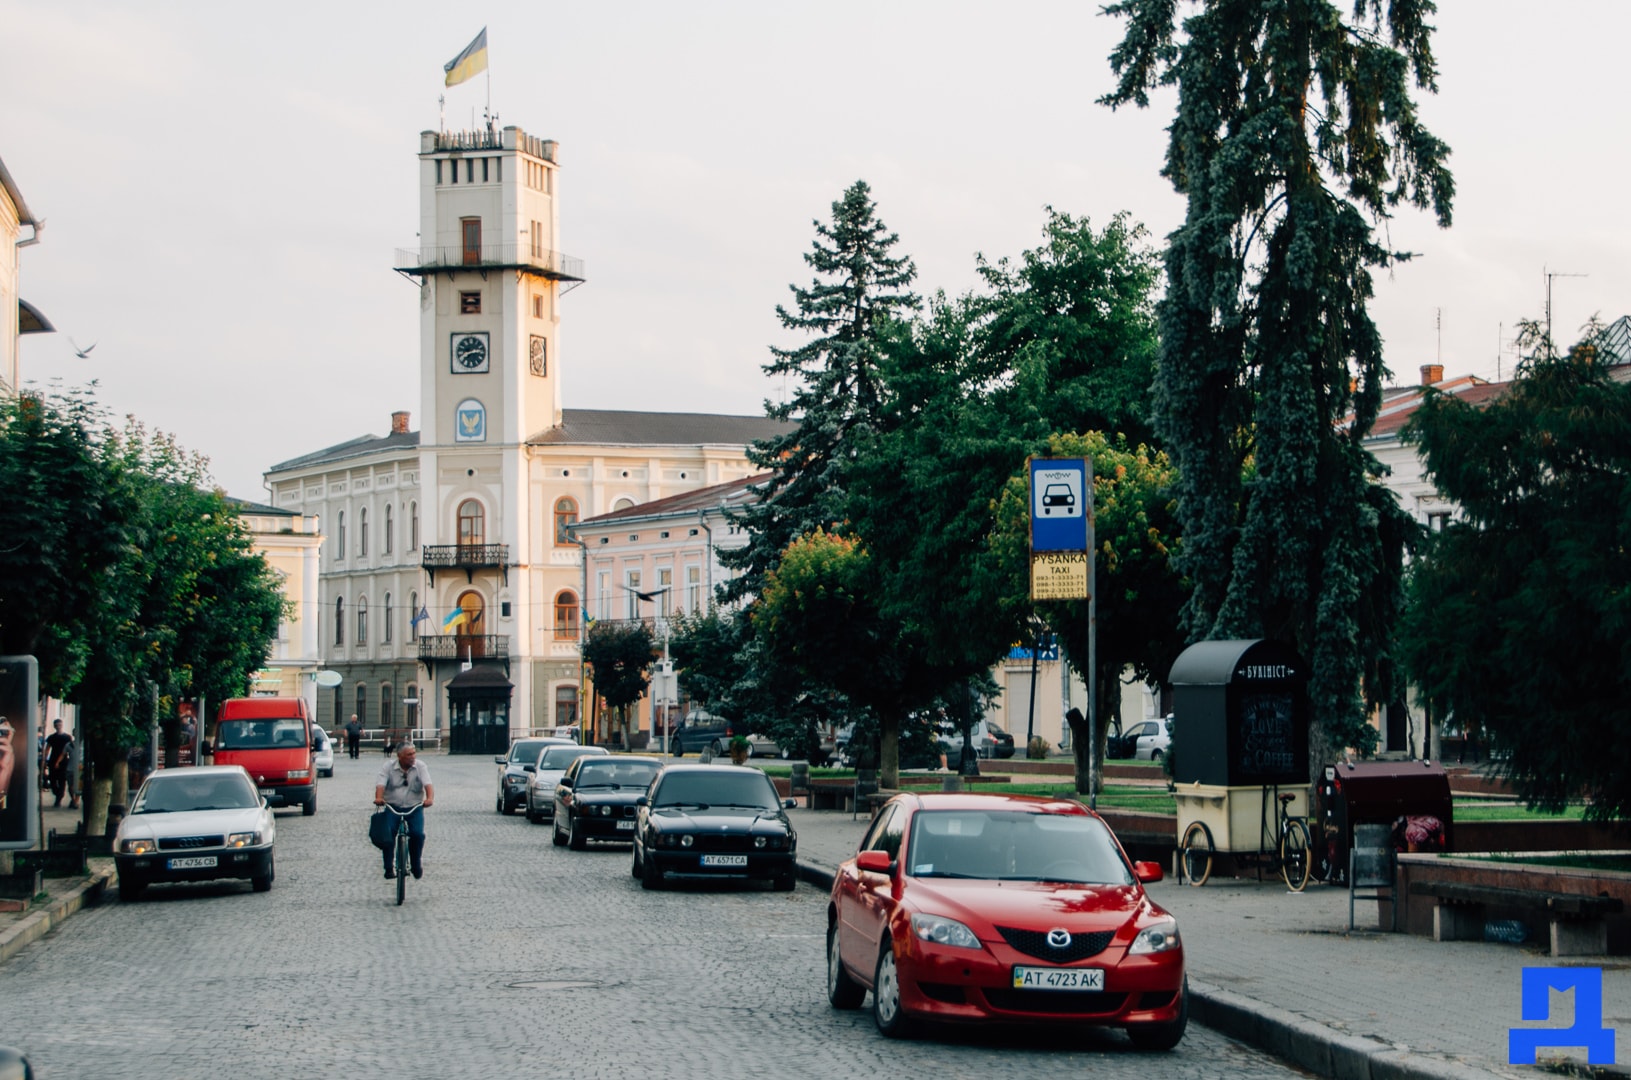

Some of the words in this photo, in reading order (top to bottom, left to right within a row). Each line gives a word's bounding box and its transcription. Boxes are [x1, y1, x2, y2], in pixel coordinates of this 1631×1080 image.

[1033, 554, 1086, 564] PYSANKA
[1050, 566, 1070, 574] TAXI
[1247, 665, 1286, 679] БУКІНІСТ
[173, 859, 184, 867] AT
[204, 857, 215, 865] CB
[705, 856, 716, 864] AT
[717, 856, 734, 864] 6571
[735, 856, 746, 864] CA
[1024, 971, 1043, 985] AT
[1047, 972, 1077, 986] 4723
[1080, 973, 1099, 987] AK
